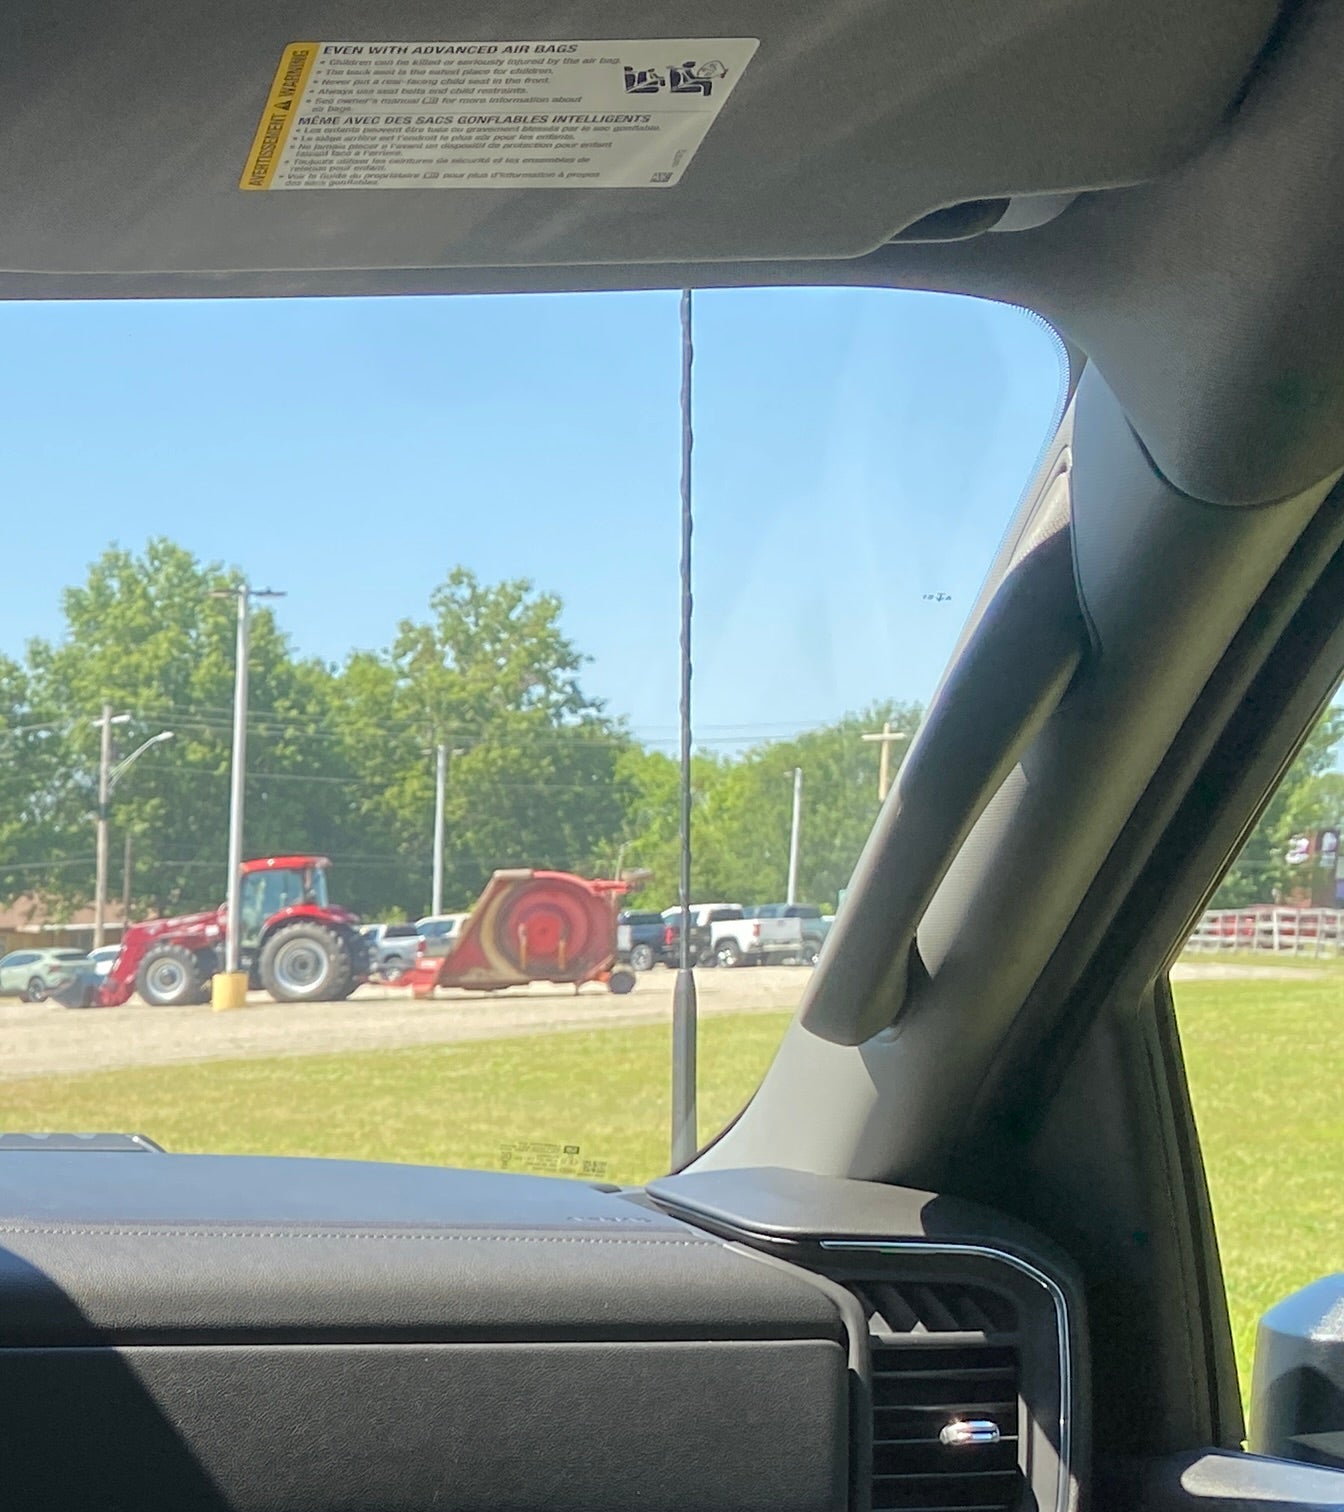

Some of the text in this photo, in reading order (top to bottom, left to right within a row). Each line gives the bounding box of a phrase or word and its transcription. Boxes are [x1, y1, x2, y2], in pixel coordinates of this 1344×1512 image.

[323, 44, 578, 54] EVEN WITH ADVANCED AIR BAGS
[278, 50, 309, 98] WARNING
[298, 115, 651, 125] MÊME AVEC DES SACS GONFLABLES INTELLIGENTS
[248, 113, 287, 187] AVERTISSEMENT
